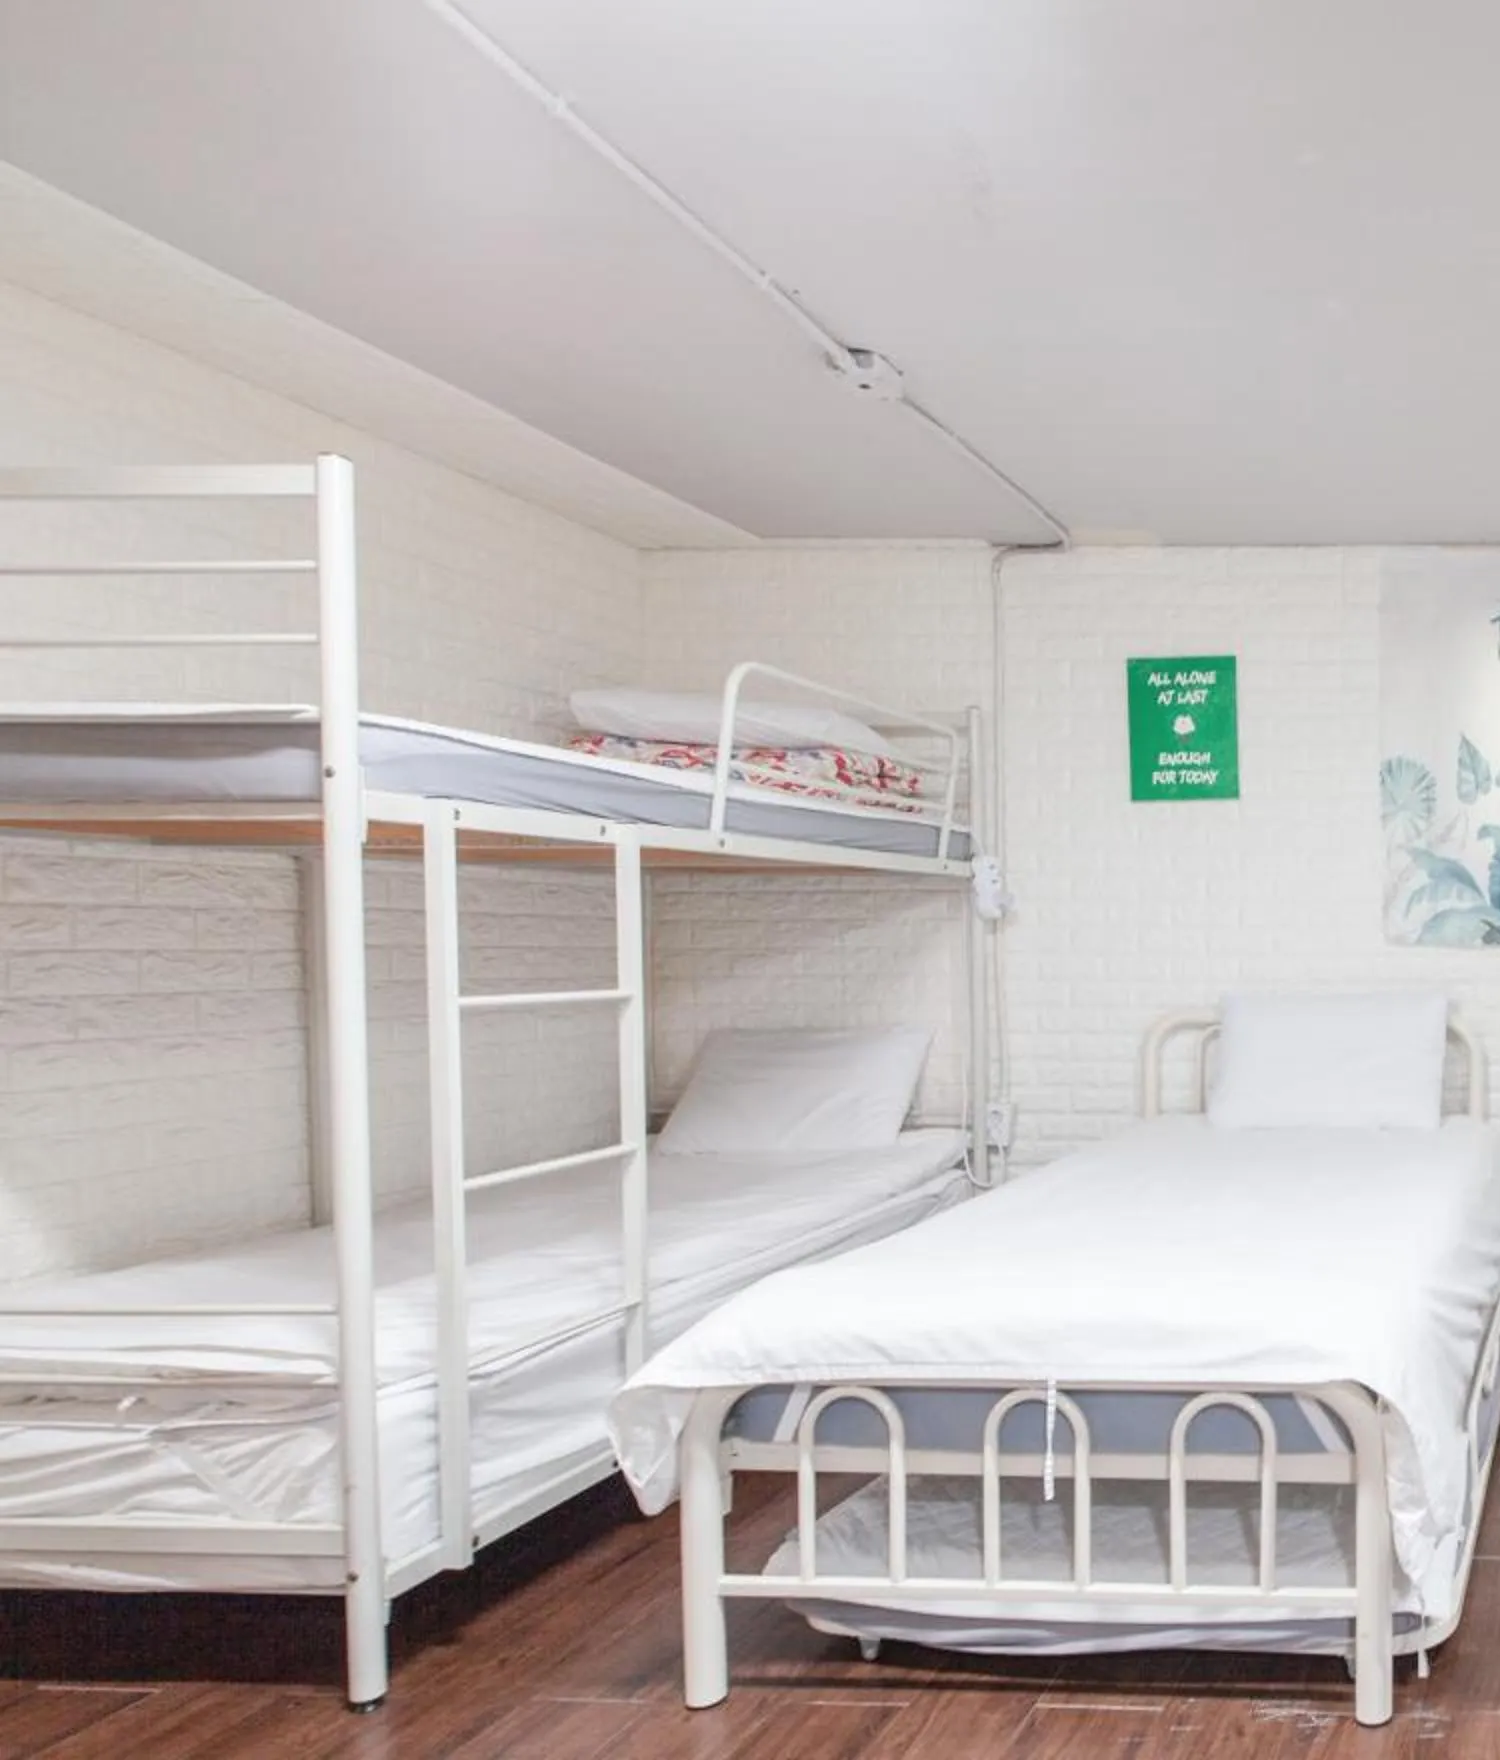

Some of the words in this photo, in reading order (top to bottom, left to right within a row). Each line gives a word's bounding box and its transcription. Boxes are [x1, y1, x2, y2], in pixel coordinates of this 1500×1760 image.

[1147, 672, 1171, 686] ALL
[1174, 670, 1217, 686] ALONE
[1157, 690, 1174, 705] AT
[1177, 688, 1209, 704] LAST
[1158, 751, 1211, 766] ENOUGH
[1152, 770, 1177, 785] FOR
[1178, 769, 1219, 785] TODAY
